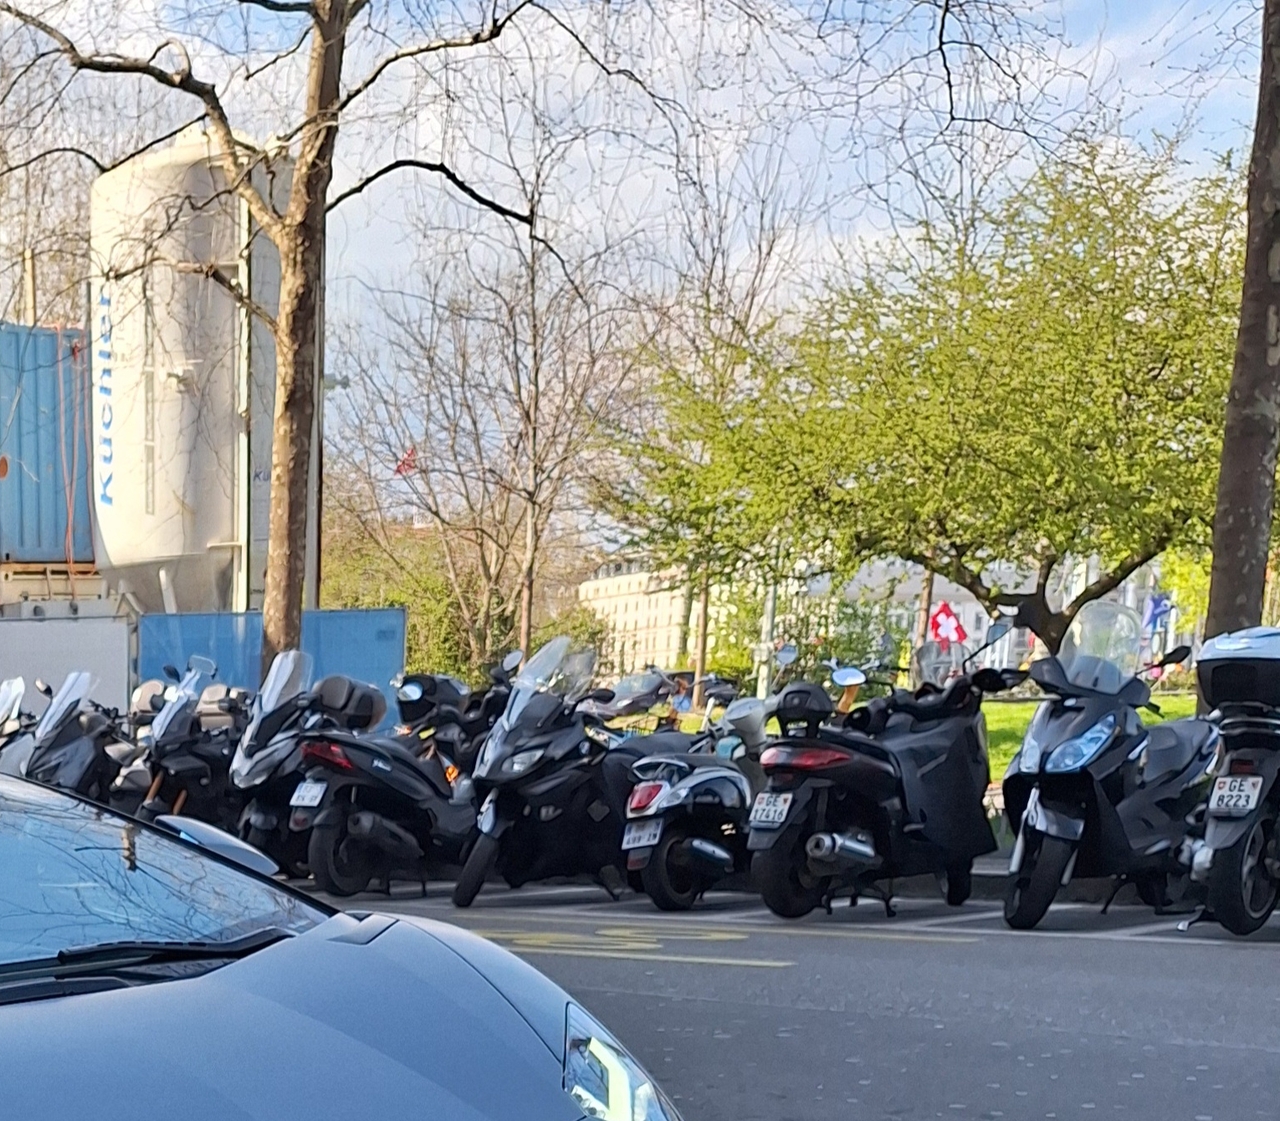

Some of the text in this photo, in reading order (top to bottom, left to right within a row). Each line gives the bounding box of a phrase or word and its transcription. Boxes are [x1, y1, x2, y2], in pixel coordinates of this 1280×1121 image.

[1229, 779, 1246, 792] GE
[766, 795, 781, 806] GE
[1216, 794, 1251, 808] 8223
[753, 808, 785, 820] 17416
